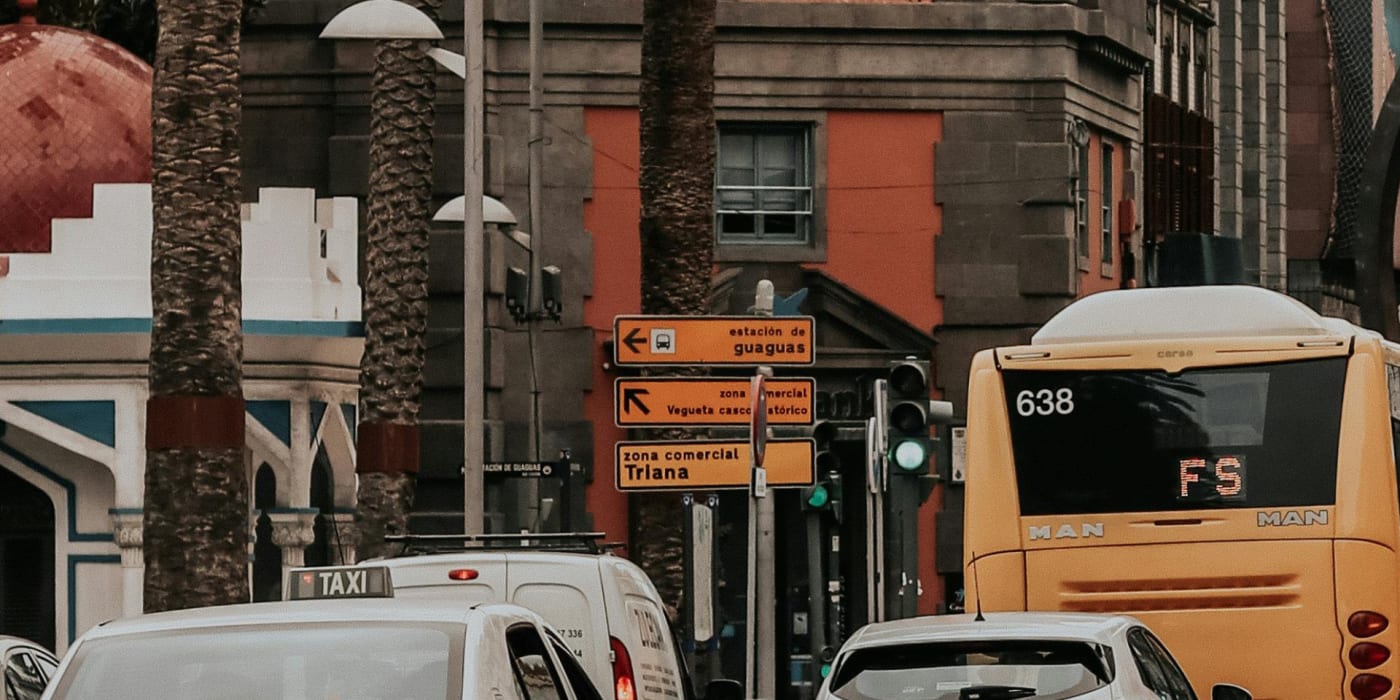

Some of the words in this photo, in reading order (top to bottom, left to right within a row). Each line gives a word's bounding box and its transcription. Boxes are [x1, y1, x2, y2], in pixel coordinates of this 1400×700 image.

[729, 326, 783, 337] estación
[790, 326, 806, 337] de
[734, 343, 806, 357] guaguas
[719, 390, 746, 399] zona
[766, 388, 808, 399] mercial
[1016, 388, 1074, 416] 638
[667, 405, 714, 417] Vegueta
[767, 404, 808, 415] stórico
[624, 451, 658, 461] zona
[665, 448, 739, 461] comercial
[624, 464, 689, 481] Triana
[1257, 510, 1329, 527] MAN
[1029, 523, 1104, 540] MAN
[319, 570, 367, 595] TAXI
[568, 629, 583, 638] 336
